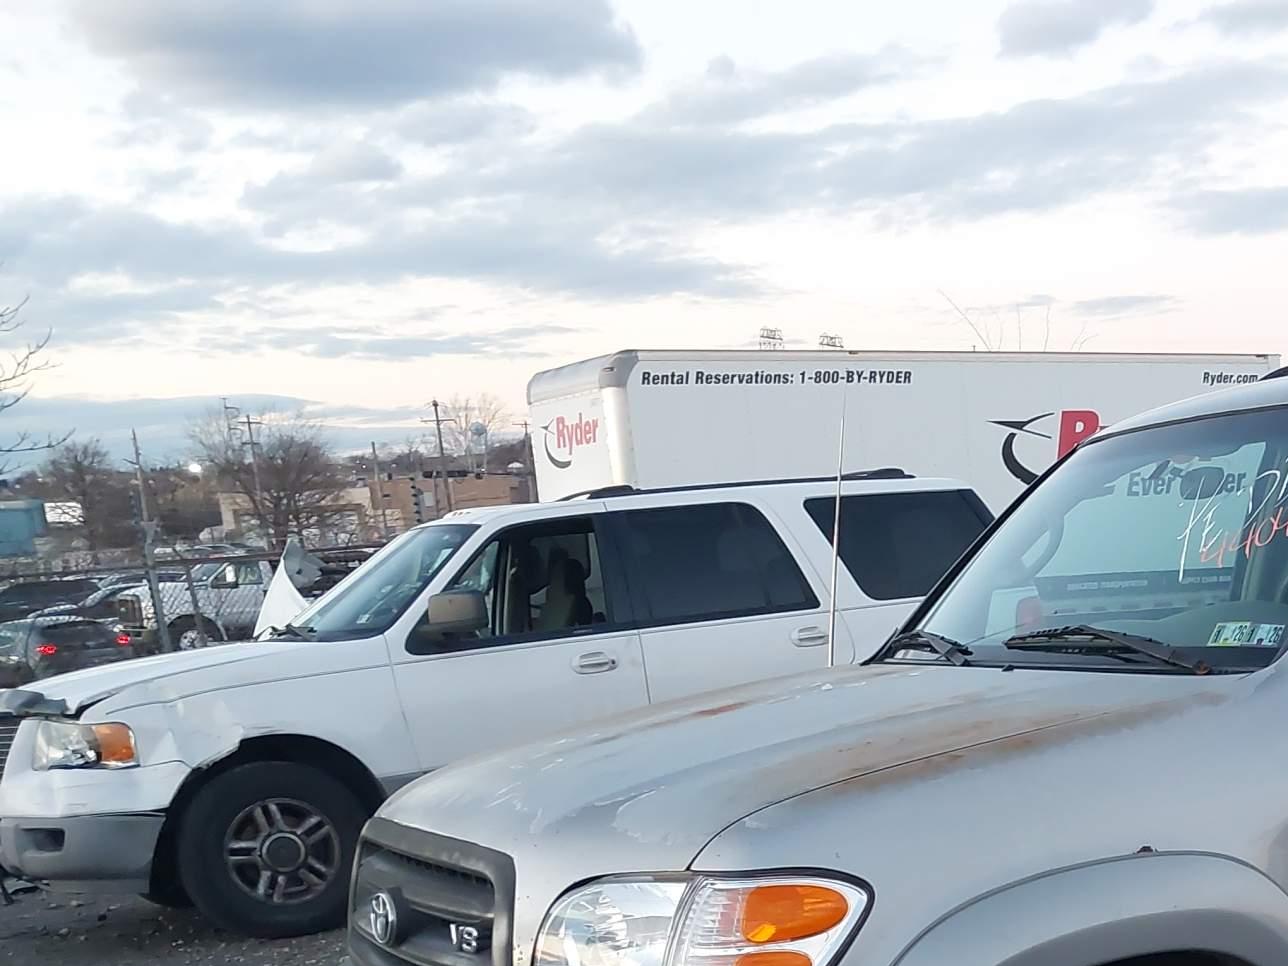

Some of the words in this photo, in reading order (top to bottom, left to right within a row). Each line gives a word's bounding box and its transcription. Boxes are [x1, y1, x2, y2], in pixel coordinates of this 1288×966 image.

[641, 371, 689, 385] Rental
[695, 371, 795, 385] Reservations:
[799, 370, 912, 384] 1-800-BY-RYDER
[1203, 371, 1259, 386] Ryder.com
[556, 412, 598, 455] Ryder
[450, 923, 478, 952] V8
